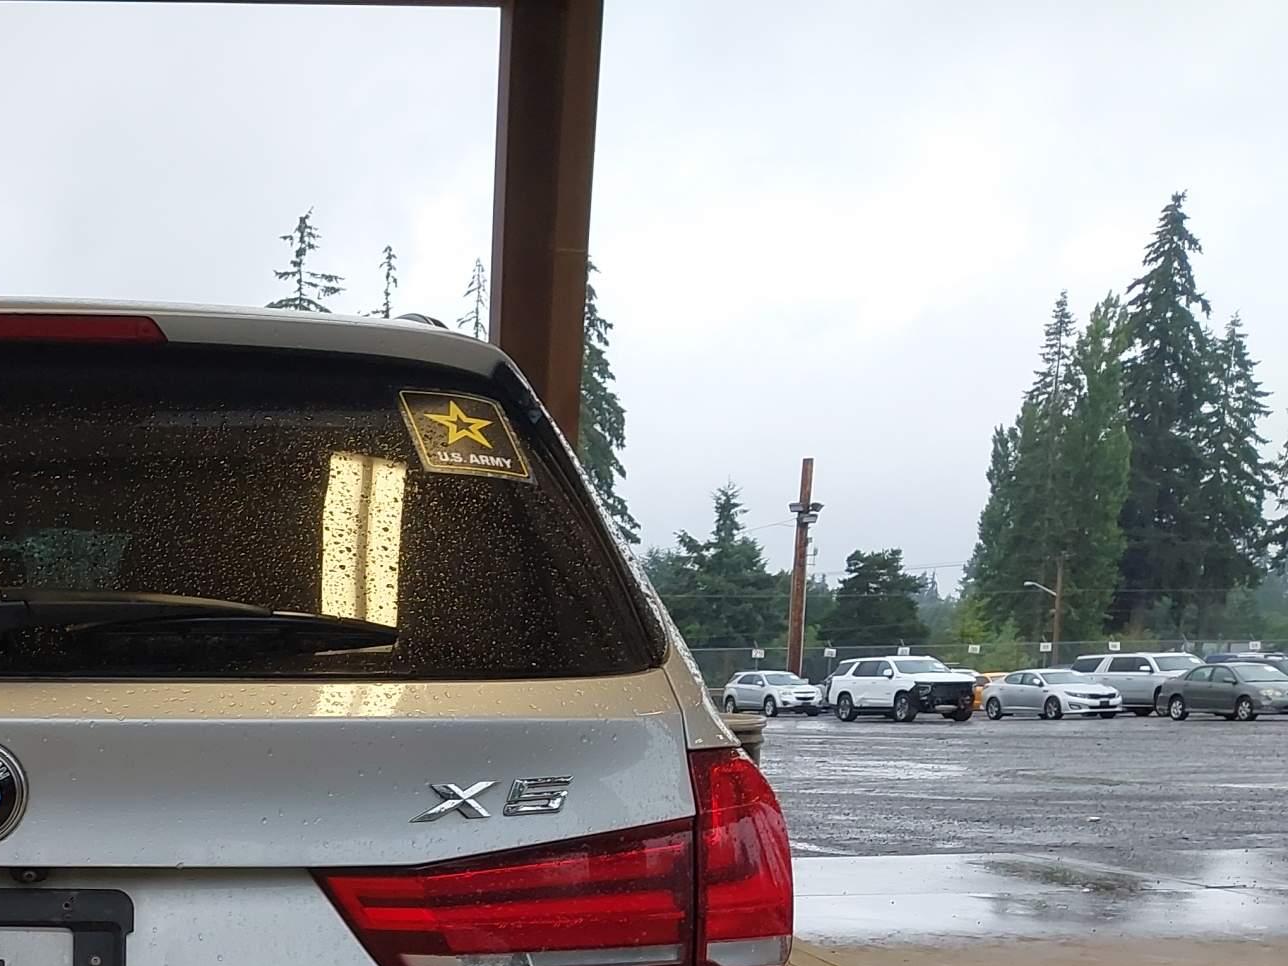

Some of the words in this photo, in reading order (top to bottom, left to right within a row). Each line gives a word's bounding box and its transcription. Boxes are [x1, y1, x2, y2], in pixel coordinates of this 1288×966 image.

[437, 451, 467, 463] U.S.
[469, 453, 512, 469] ARMY
[409, 776, 575, 823] X5
